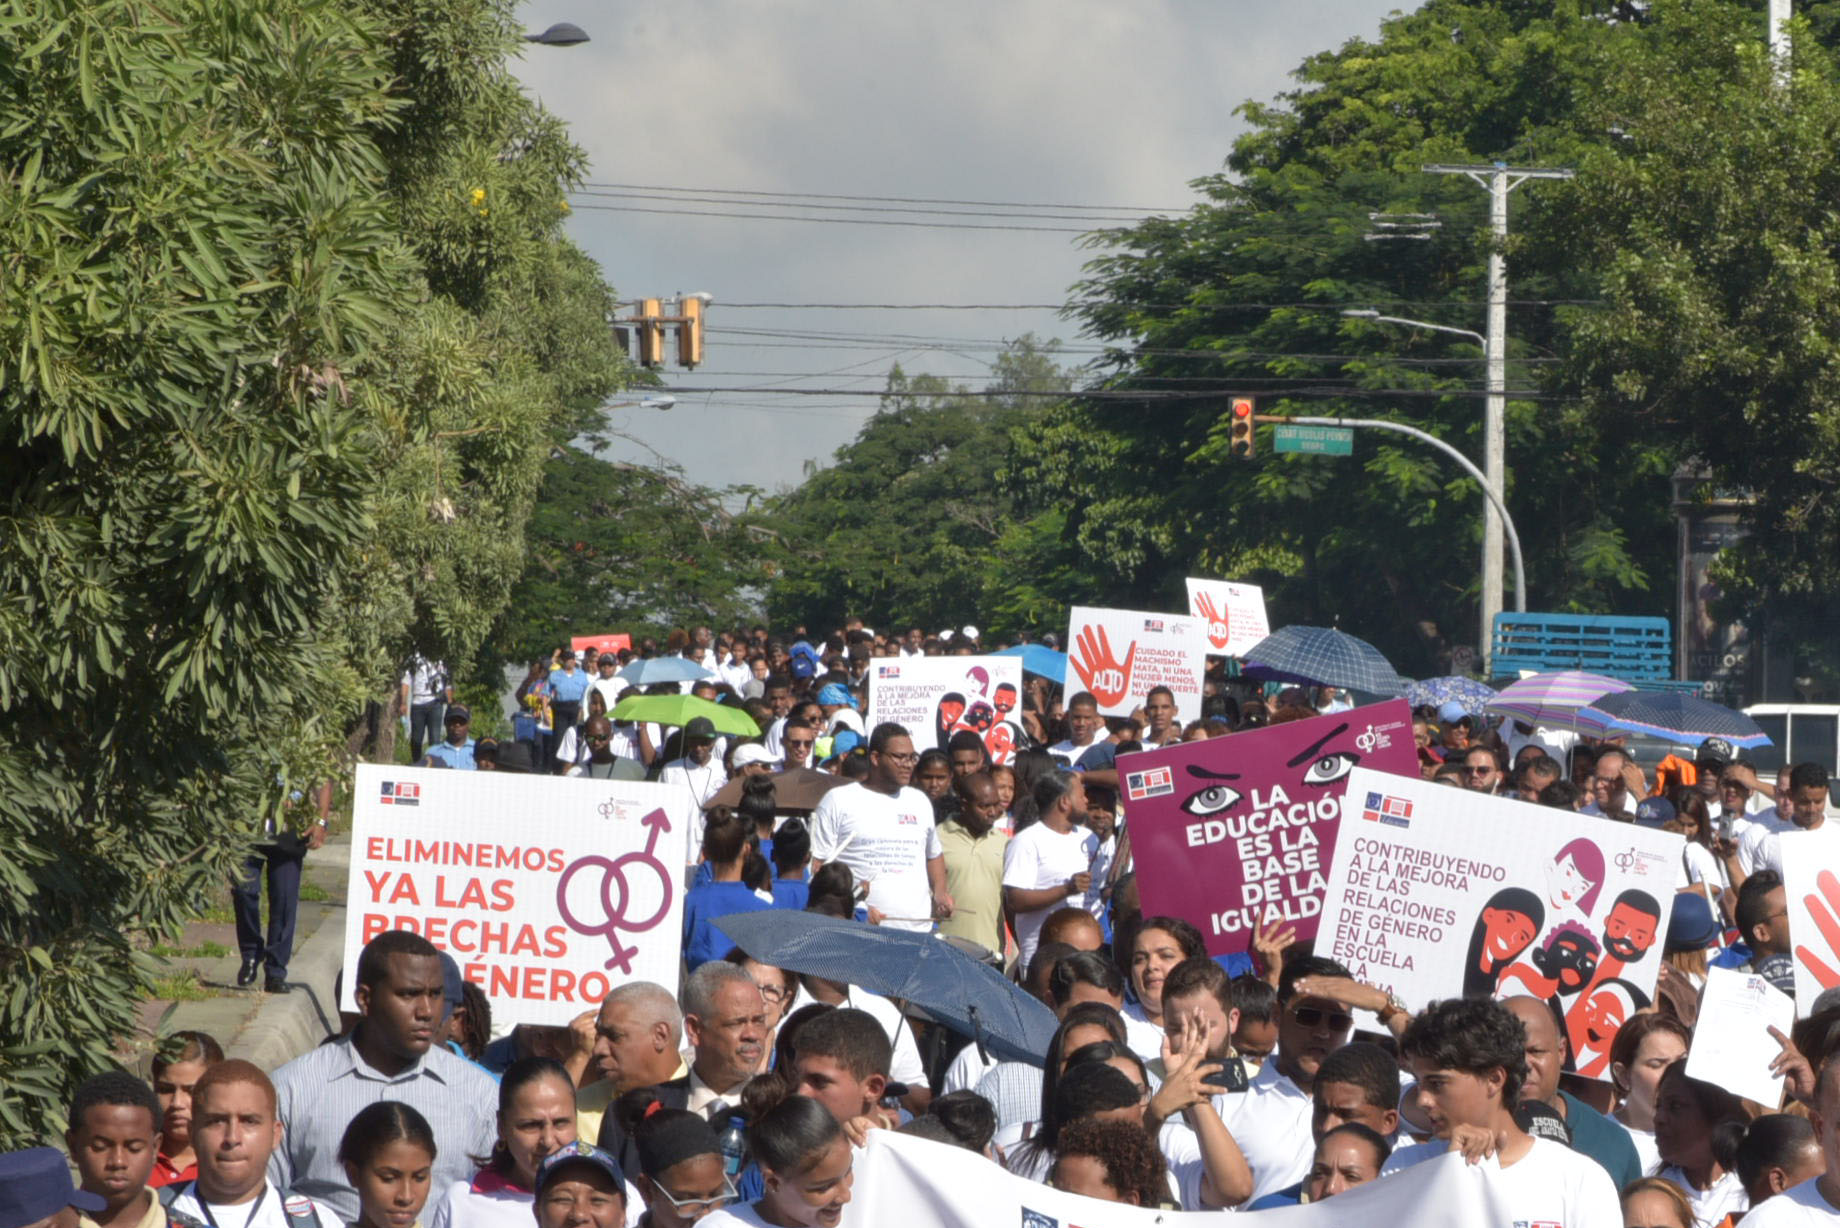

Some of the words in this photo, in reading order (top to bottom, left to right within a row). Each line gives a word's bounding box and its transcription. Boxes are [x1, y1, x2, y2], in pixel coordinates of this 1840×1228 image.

[1134, 656, 1182, 666] MACHISMO
[1135, 647, 1175, 658] CUIDADO
[1178, 650, 1188, 658] EL
[1091, 668, 1124, 695] ALTO
[1132, 682, 1142, 690] NI
[1133, 672, 1162, 682] MUJER
[1163, 666, 1171, 674] NI
[1173, 667, 1193, 676] UNA
[1250, 784, 1290, 812] LA
[366, 836, 565, 873] ELIMINEMOS
[1236, 834, 1273, 861] ES
[1280, 825, 1320, 851] LA
[1353, 837, 1507, 882] CONTRIBUYENDO
[1242, 848, 1320, 883] BASE
[1347, 869, 1372, 888] DE
[1376, 876, 1410, 896] LAS
[1350, 854, 1362, 870] A
[1367, 857, 1390, 876] LA
[1395, 863, 1469, 892] MEJORA
[363, 870, 421, 906] YA
[435, 875, 515, 912] LAS
[1241, 880, 1282, 906] DE
[1289, 870, 1328, 897] LA
[1211, 896, 1322, 935] IGUALD
[1343, 888, 1457, 926] RELACIONES
[1336, 924, 1360, 942] EN
[1364, 931, 1387, 949] LA
[1339, 908, 1364, 927] DE
[1368, 911, 1443, 943] GÉNERO
[1332, 940, 1414, 972] ESCUELA
[463, 954, 611, 1004] ÉNERO
